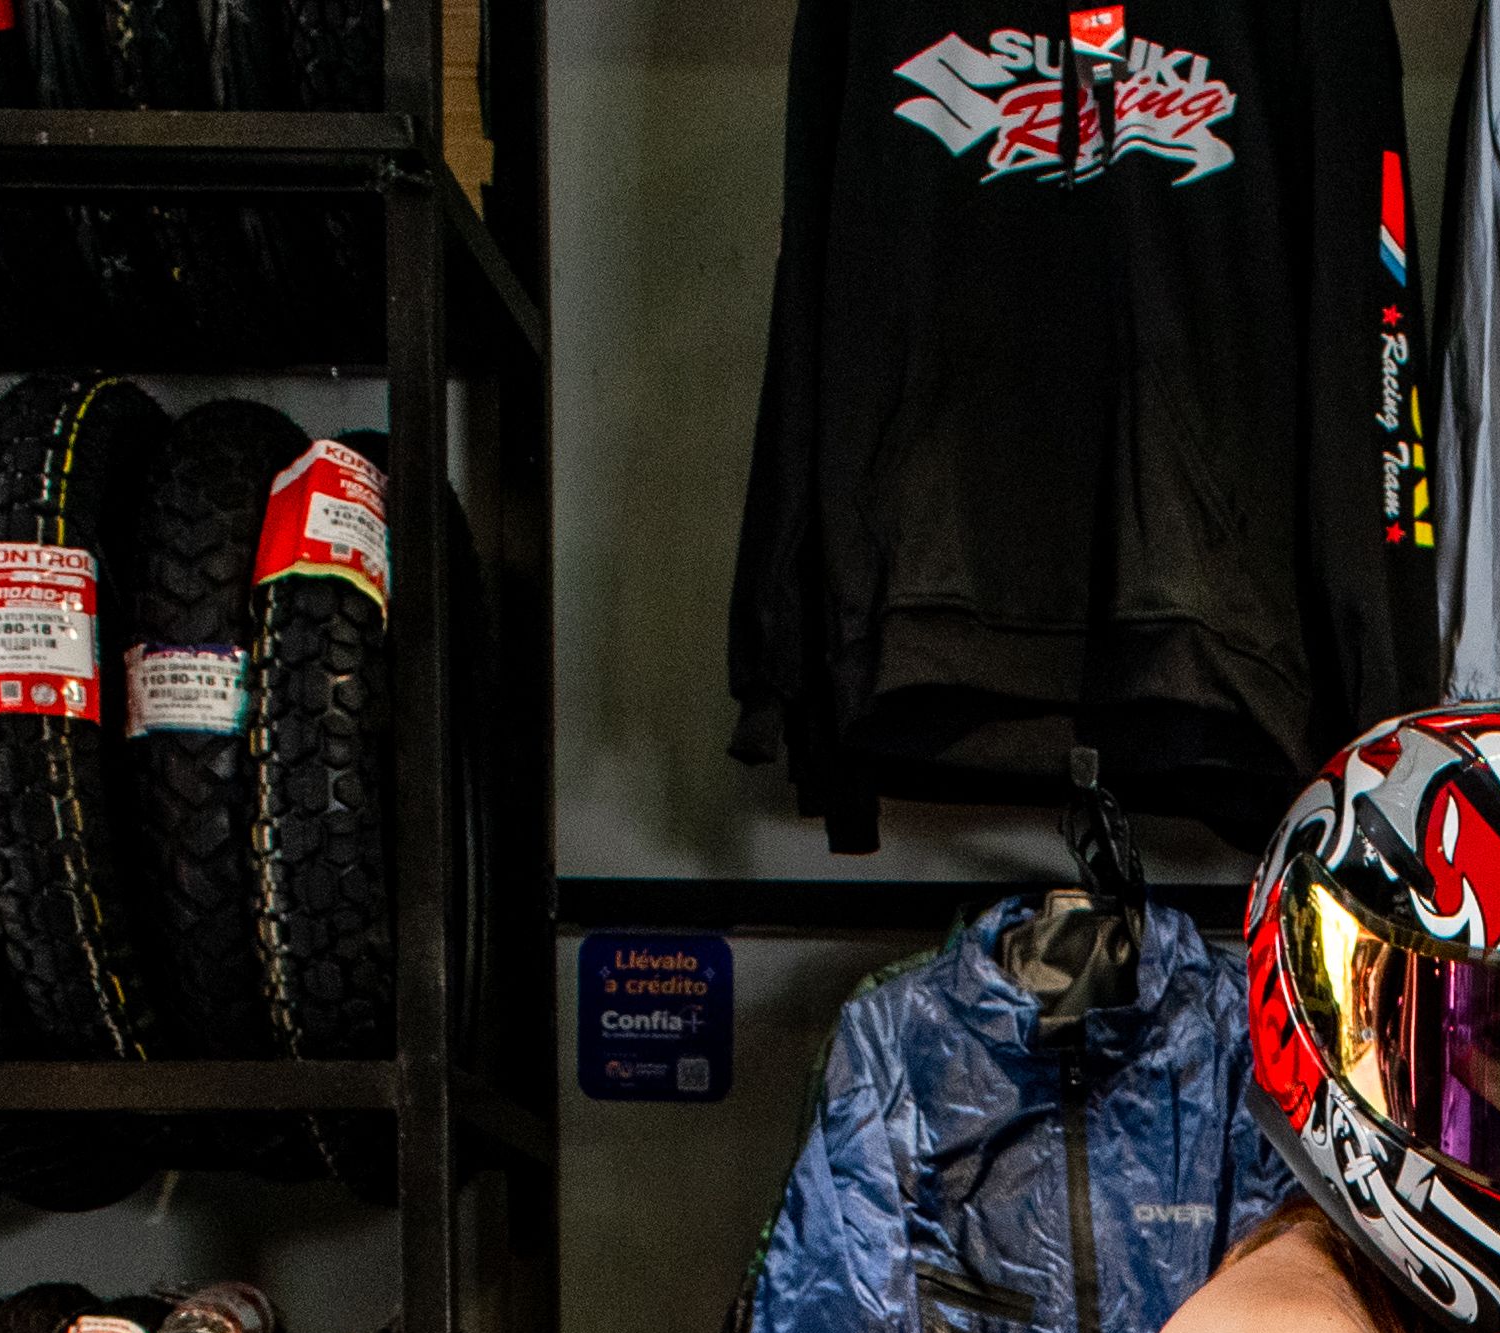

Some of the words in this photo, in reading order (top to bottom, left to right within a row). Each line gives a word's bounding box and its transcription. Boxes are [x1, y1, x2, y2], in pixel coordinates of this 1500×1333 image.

[988, 30, 1211, 91] SUKI
[1374, 331, 1408, 433] Racing
[1382, 440, 1410, 519] Team
[604, 978, 618, 994] a
[625, 974, 708, 996] crédito
[614, 949, 699, 973] Llévalo
